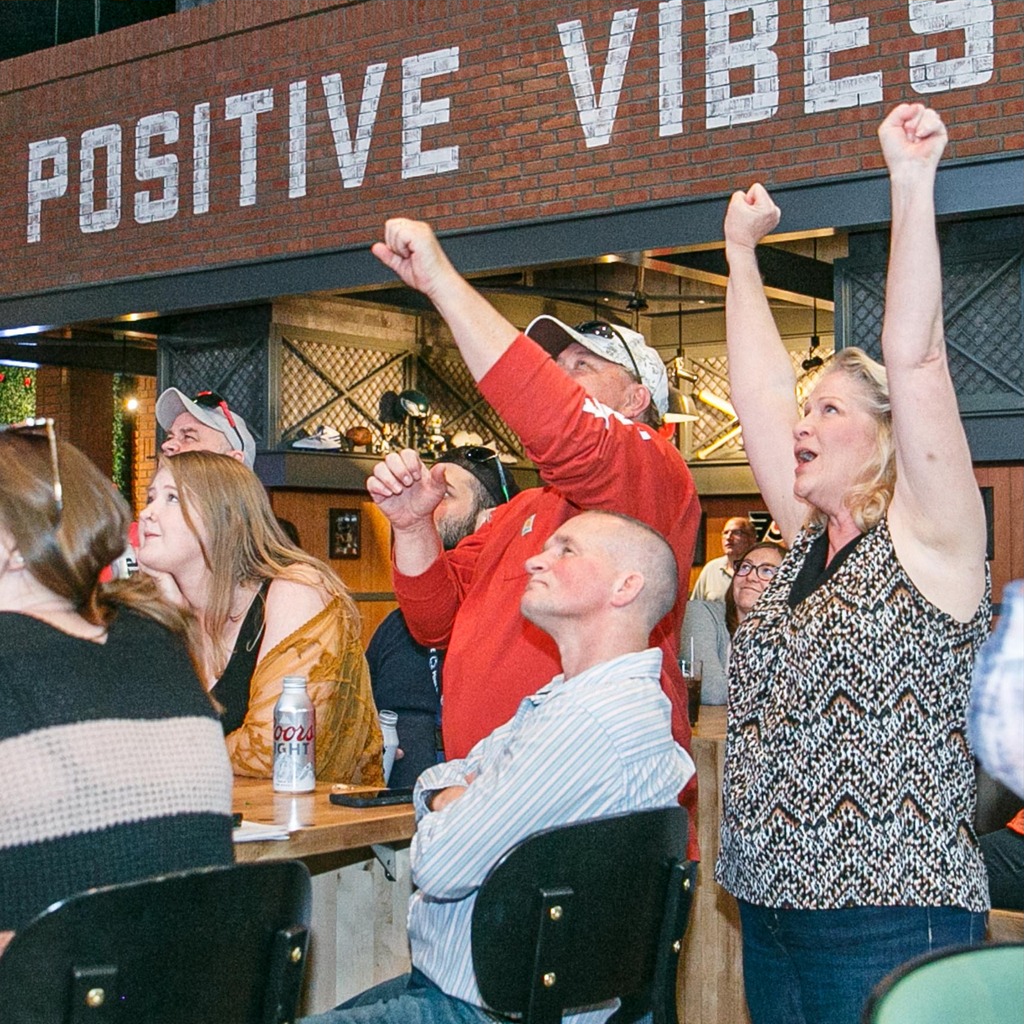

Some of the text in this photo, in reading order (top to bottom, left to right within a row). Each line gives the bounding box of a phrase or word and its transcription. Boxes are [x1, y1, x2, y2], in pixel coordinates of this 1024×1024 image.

[27, 0, 994, 244] POSITIVE VIBES
[273, 724, 314, 742] oors
[274, 743, 310, 756] IGHT
